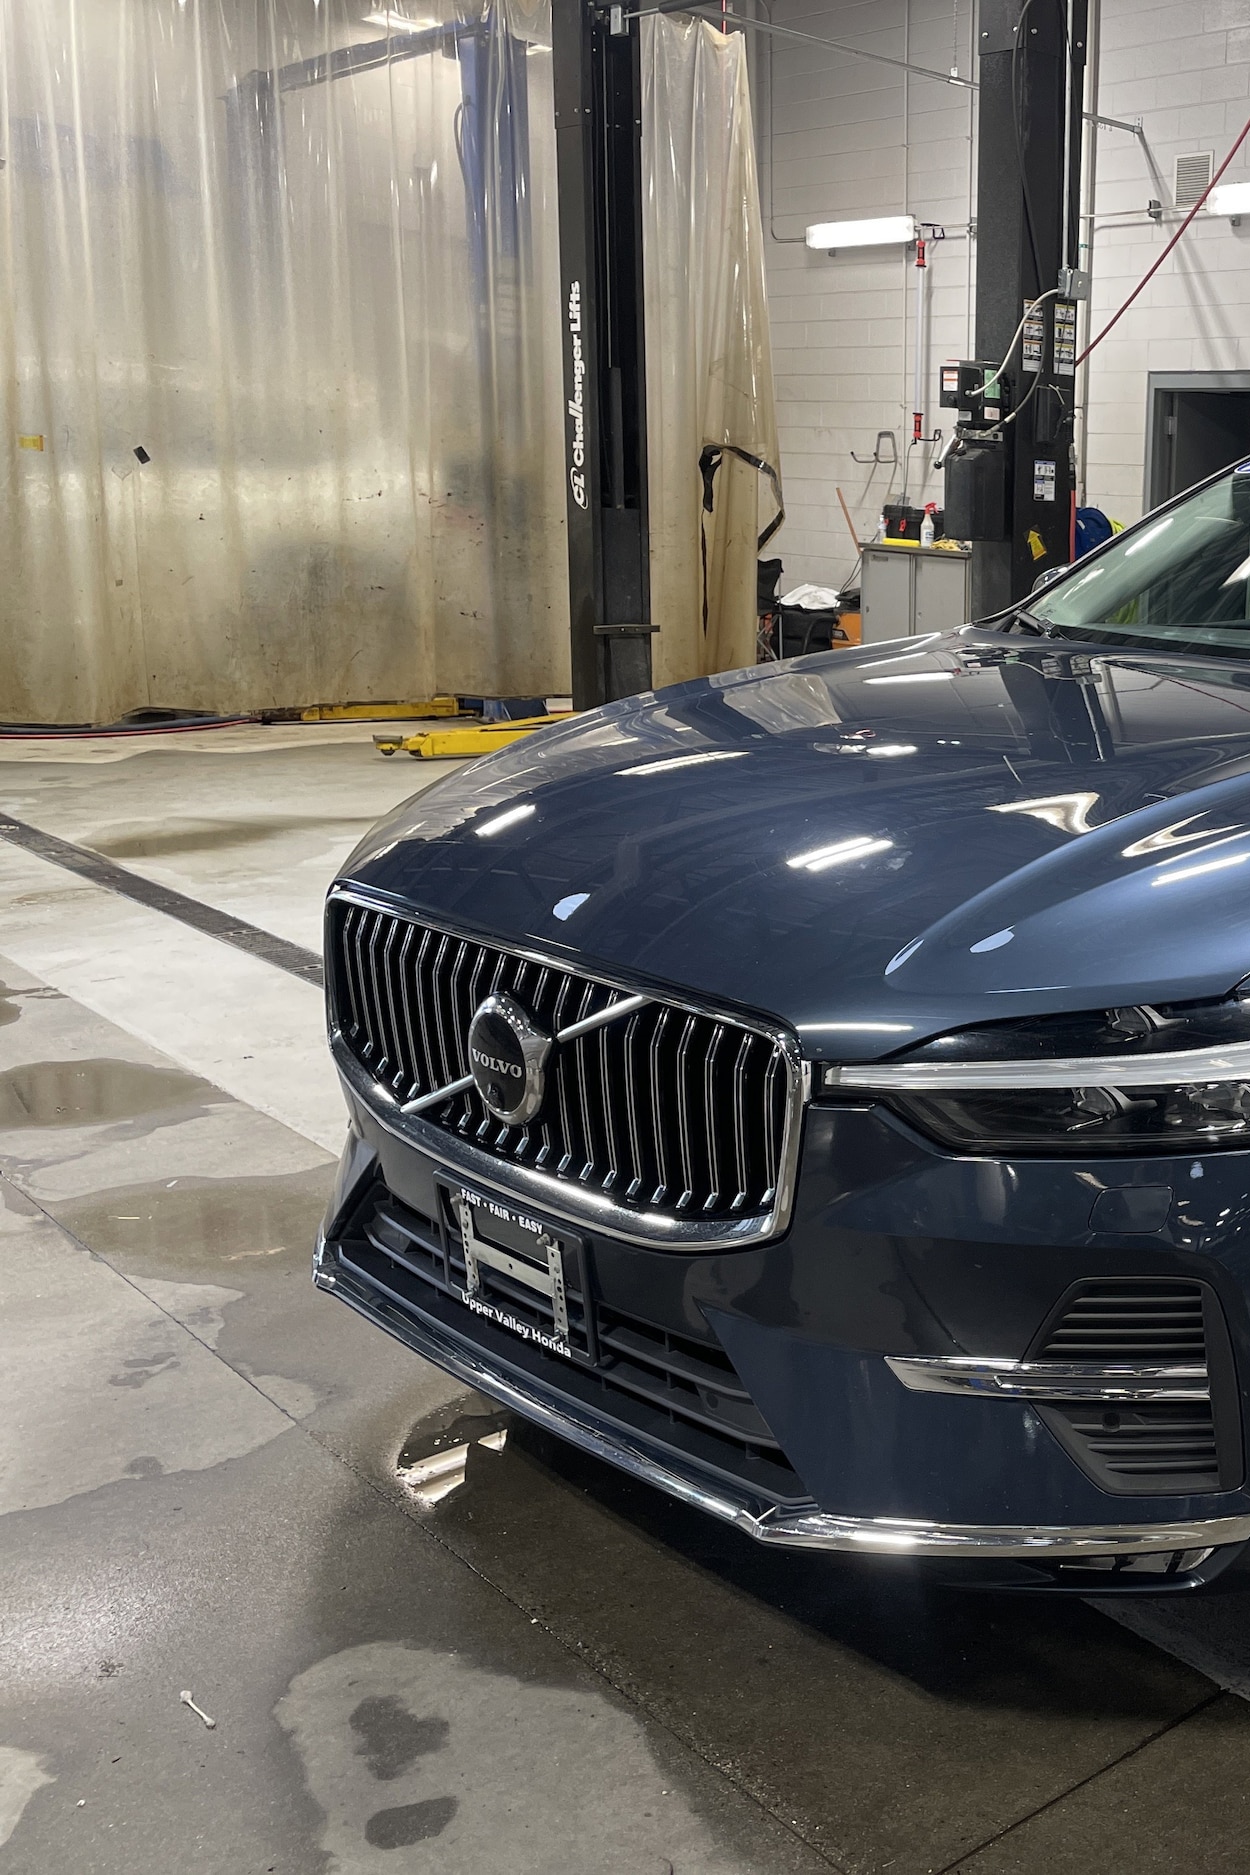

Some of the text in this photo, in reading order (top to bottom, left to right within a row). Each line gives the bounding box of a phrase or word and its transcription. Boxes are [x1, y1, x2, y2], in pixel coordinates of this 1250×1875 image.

[569, 280, 582, 331] Lifts
[568, 334, 585, 466] Challenger
[472, 1048, 522, 1078] VOLVO
[461, 1188, 543, 1235] FAST FAIR EASY
[462, 1290, 572, 1358] Upper Valley Honda
